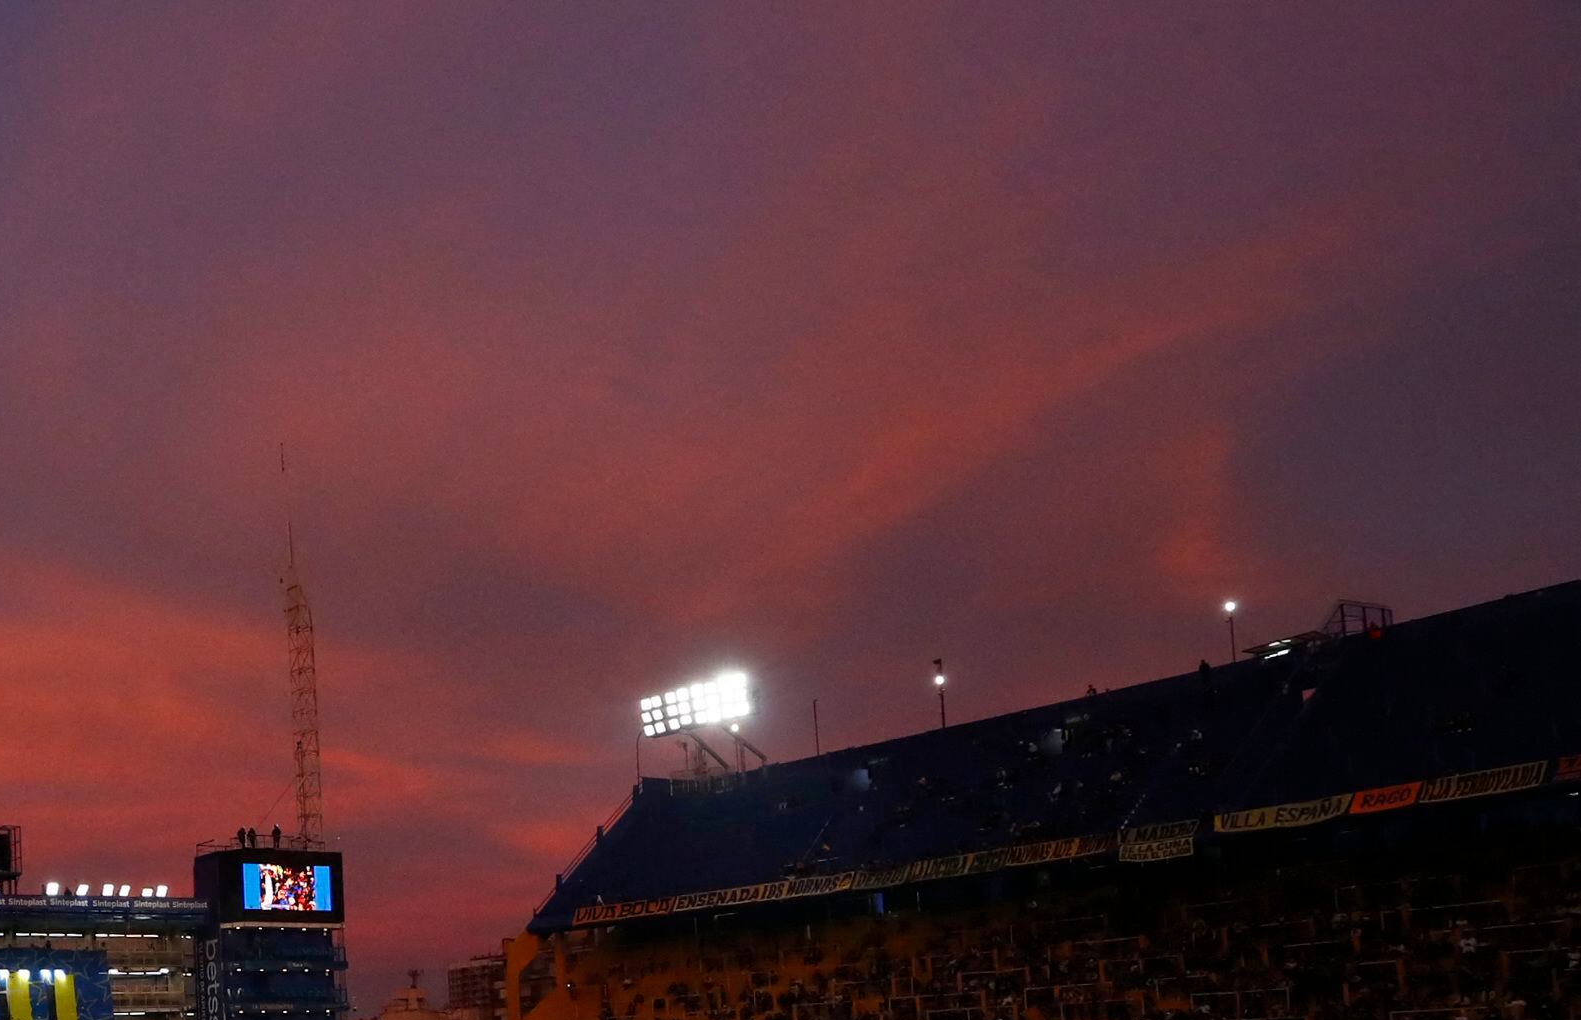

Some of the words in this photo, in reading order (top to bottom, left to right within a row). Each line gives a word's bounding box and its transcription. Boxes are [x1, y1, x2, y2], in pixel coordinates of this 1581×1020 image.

[1360, 787, 1412, 808] RAGO
[1221, 813, 1267, 829] VILLA
[8, 897, 47, 908] Sinteplast
[49, 897, 88, 909] Sinteplast
[92, 899, 129, 910] Sinteplast
[133, 900, 170, 910] Sinteplast
[675, 886, 759, 911] ENSENADA
